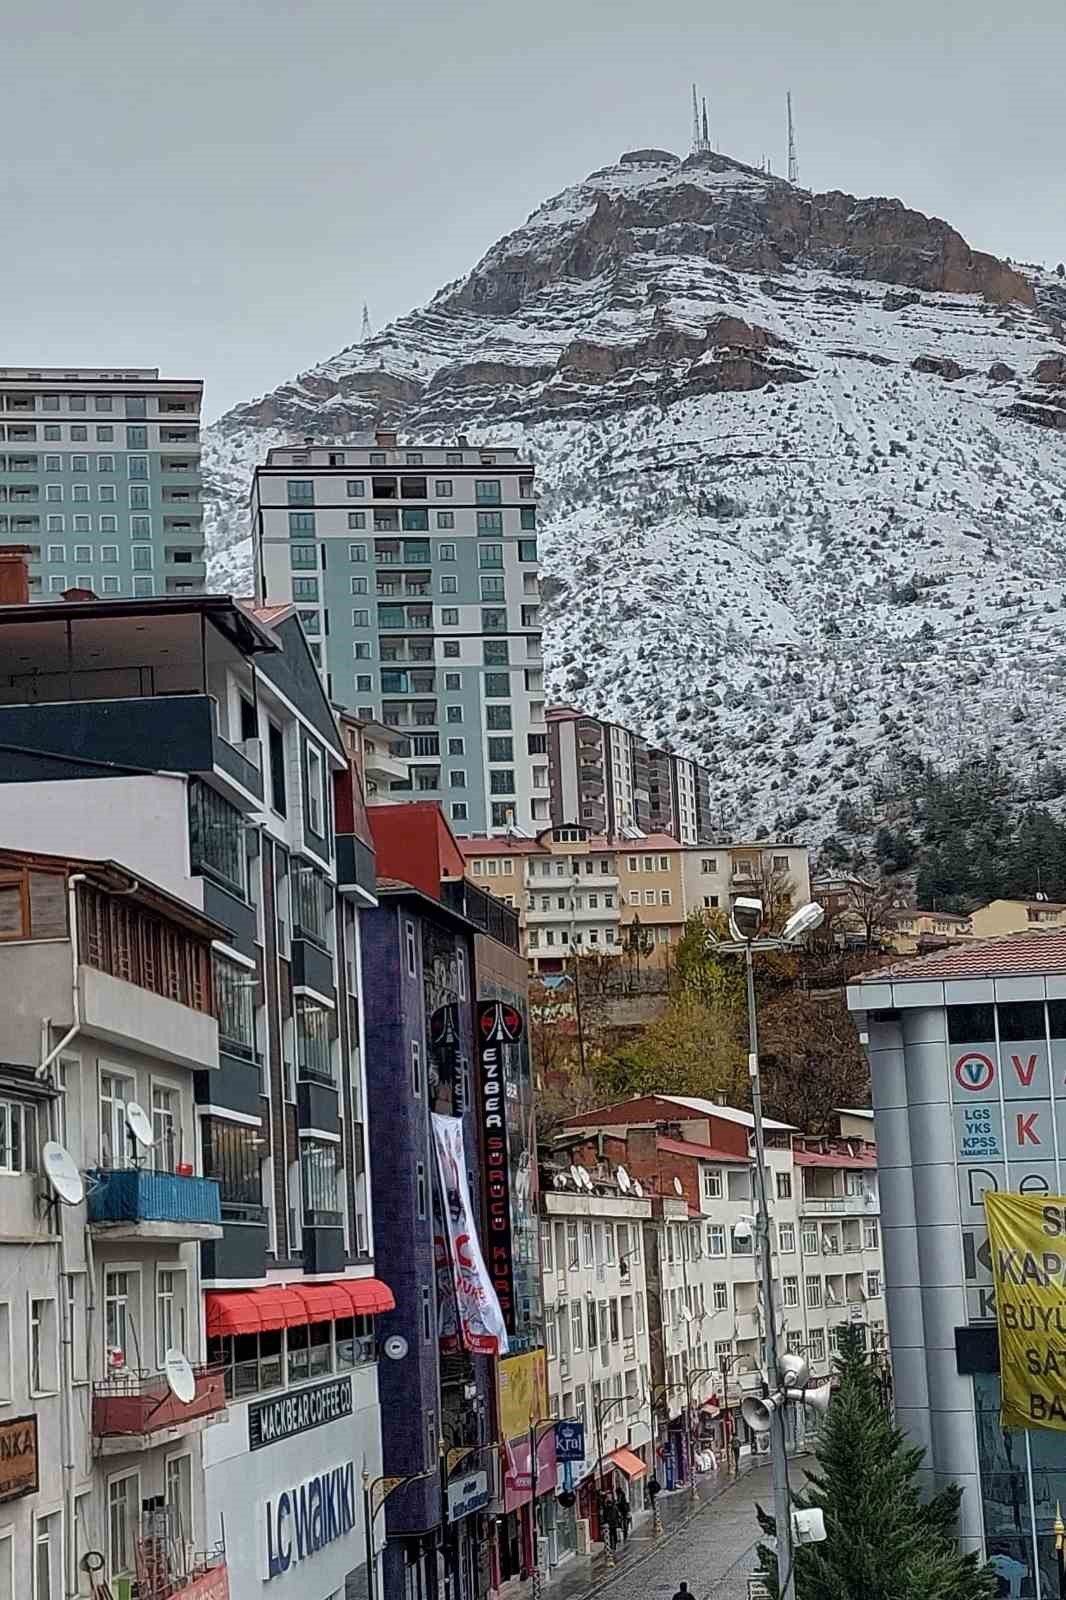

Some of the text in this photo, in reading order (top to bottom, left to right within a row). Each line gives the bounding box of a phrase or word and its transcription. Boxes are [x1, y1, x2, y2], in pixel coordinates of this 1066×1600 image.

[482, 1047, 502, 1129] EZBER
[965, 1109, 990, 1120] LGS
[966, 1123, 991, 1134] YKS
[963, 1137, 996, 1148] KPSS
[487, 1136, 507, 1231] SÜRÜCÜ
[1043, 1206, 1066, 1236] S
[999, 1249, 1066, 1288] KAP
[260, 1394, 309, 1442] MACKBEAR
[310, 1384, 340, 1423] COFFEE
